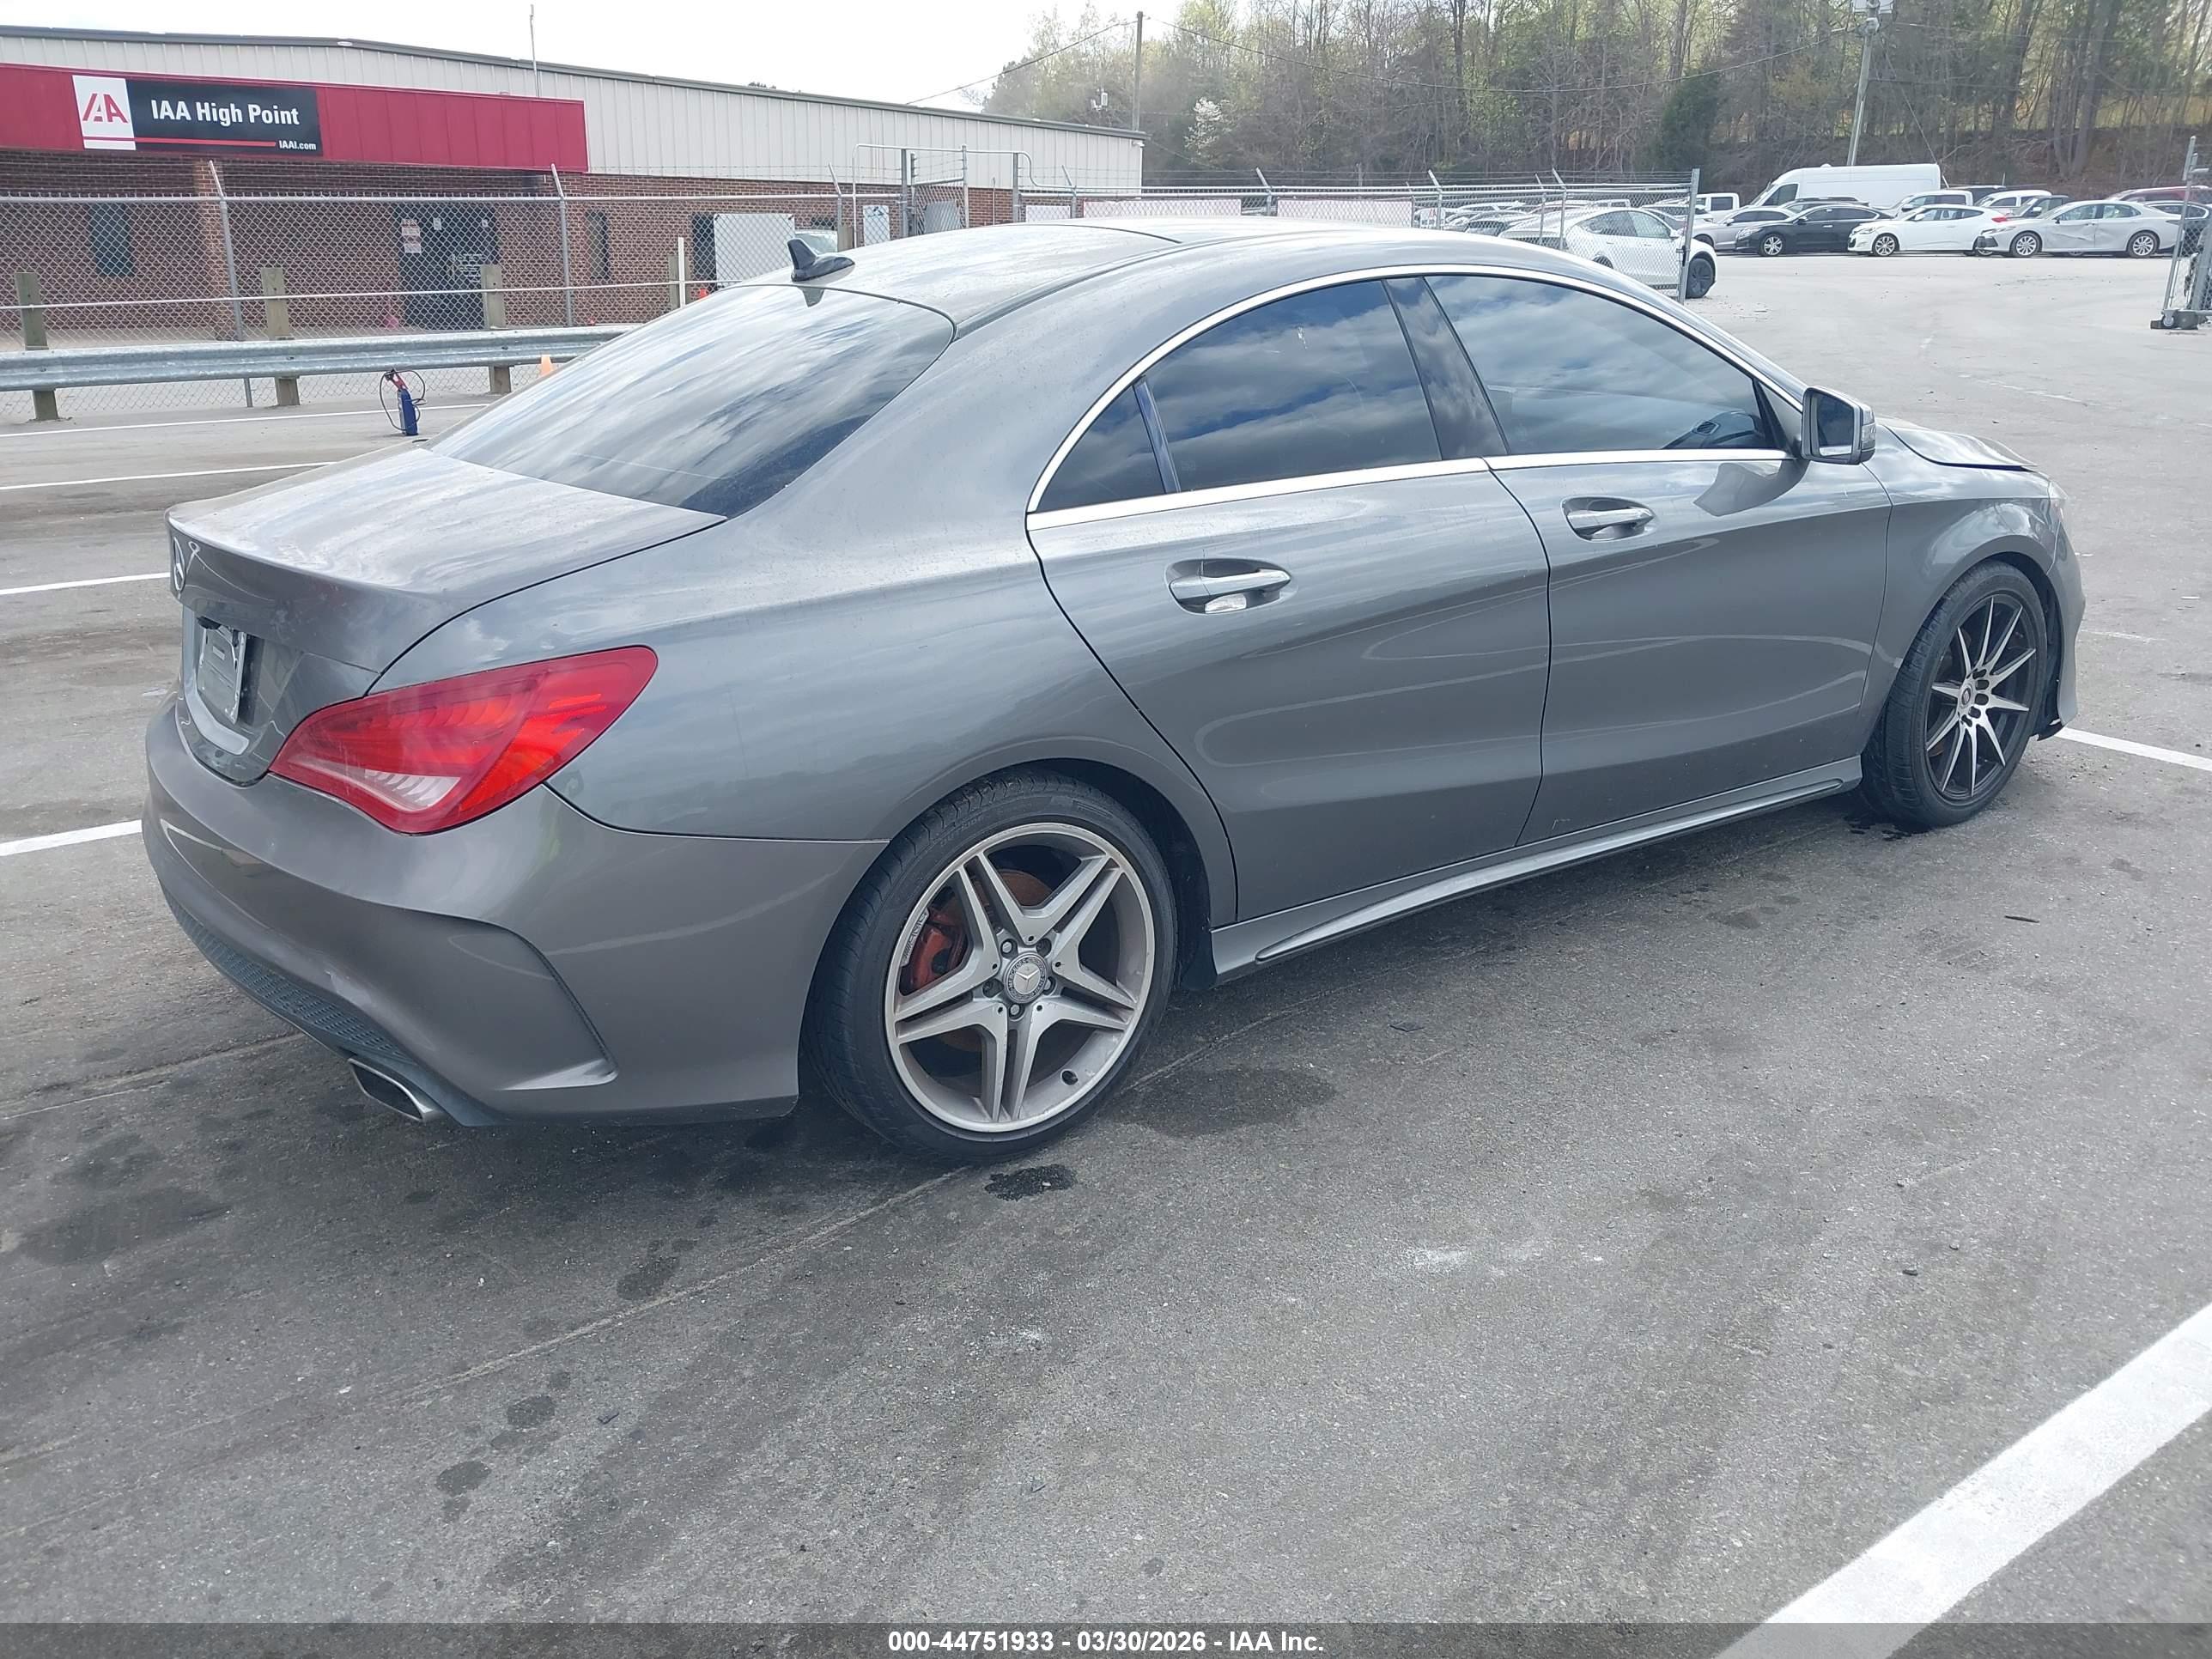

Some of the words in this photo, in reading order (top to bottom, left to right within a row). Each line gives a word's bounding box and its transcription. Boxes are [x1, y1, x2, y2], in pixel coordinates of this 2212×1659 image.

[151, 100, 191, 121] IAA
[196, 101, 243, 127] High
[248, 104, 300, 125] Point
[279, 140, 317, 150] IAAI.com
